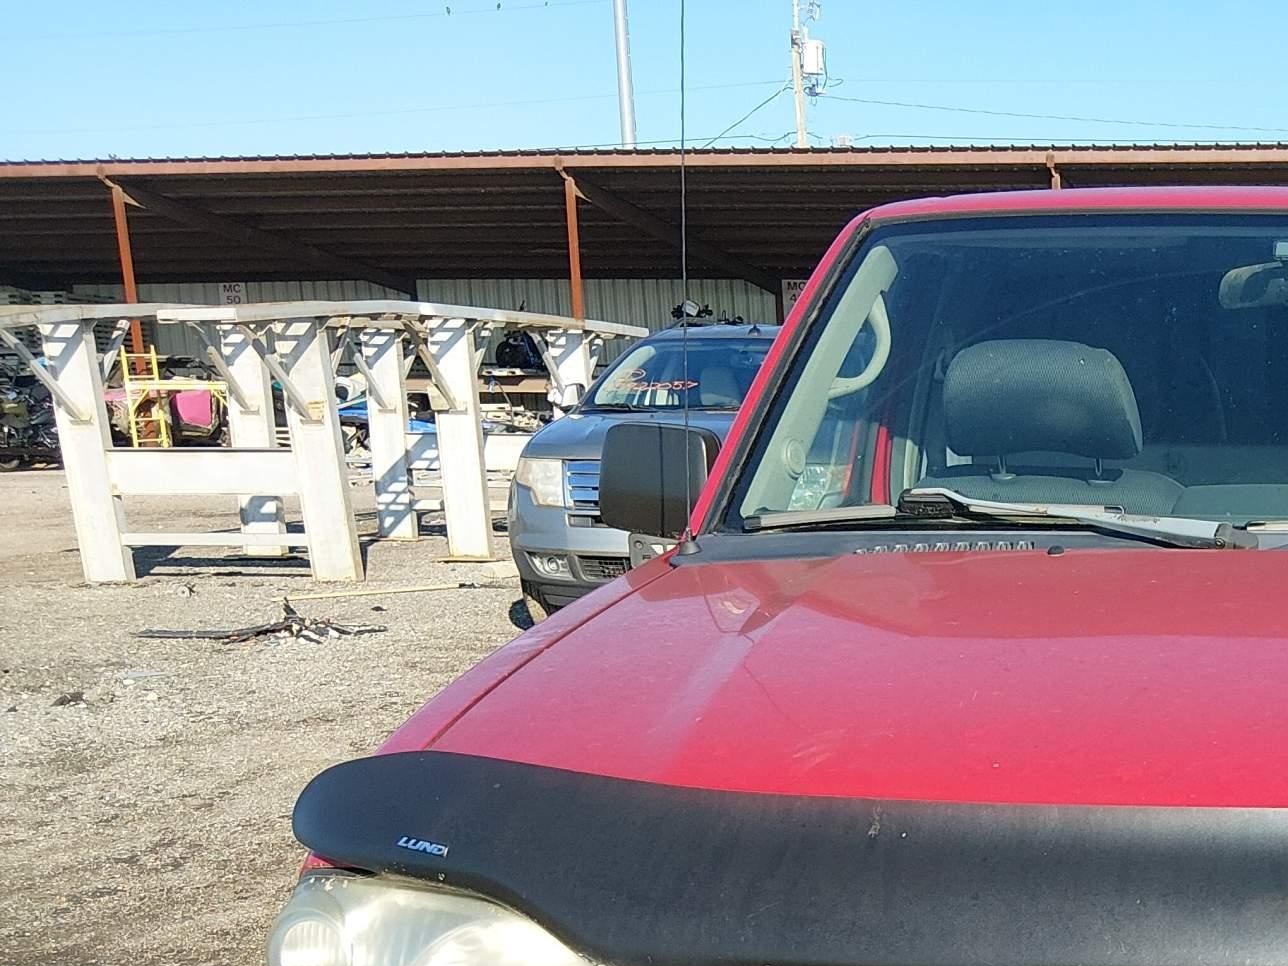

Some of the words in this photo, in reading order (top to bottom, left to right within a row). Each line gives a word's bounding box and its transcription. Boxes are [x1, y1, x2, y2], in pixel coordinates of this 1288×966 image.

[223, 283, 241, 293] MC
[226, 295, 241, 305] 50
[397, 836, 447, 857] LUND
